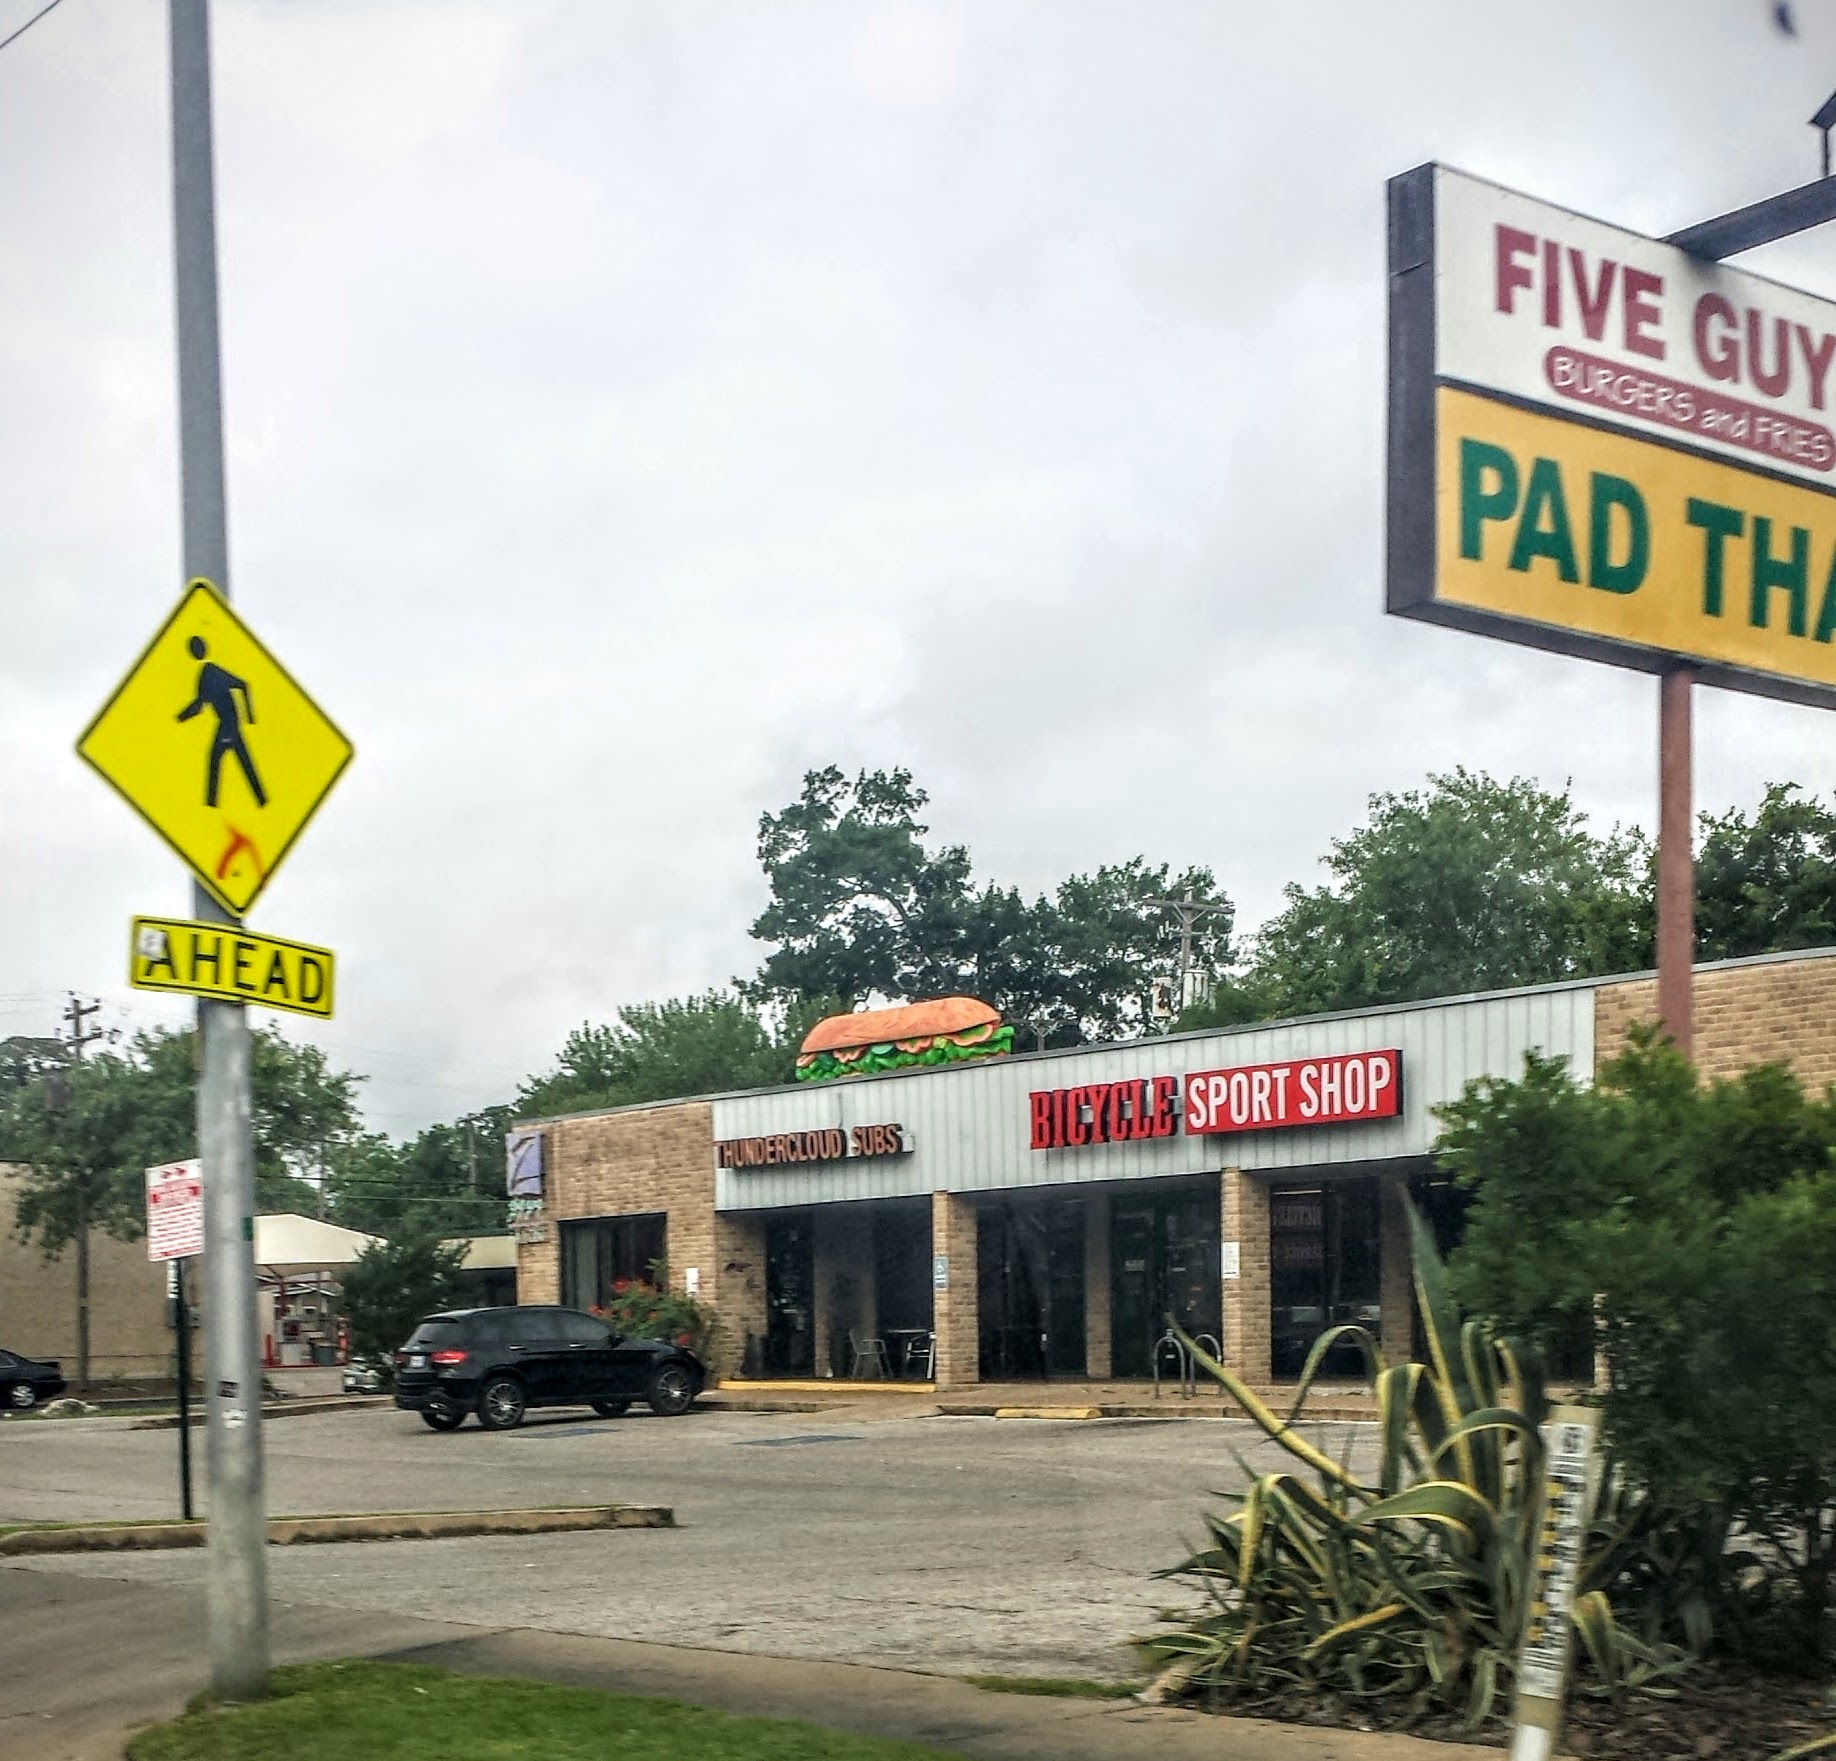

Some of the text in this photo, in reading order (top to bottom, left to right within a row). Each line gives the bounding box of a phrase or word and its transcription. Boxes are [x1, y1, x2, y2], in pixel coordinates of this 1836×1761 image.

[1494, 223, 1836, 411] FIVE GUY
[1552, 355, 1832, 464] BURGERS and FRIES
[1459, 437, 1653, 595] PAD
[145, 929, 324, 1004] AHEAD
[715, 1124, 901, 1168] THUNDERCLOUD SUBS
[1030, 1057, 1392, 1149] BICYCLE SPORT SHOP
